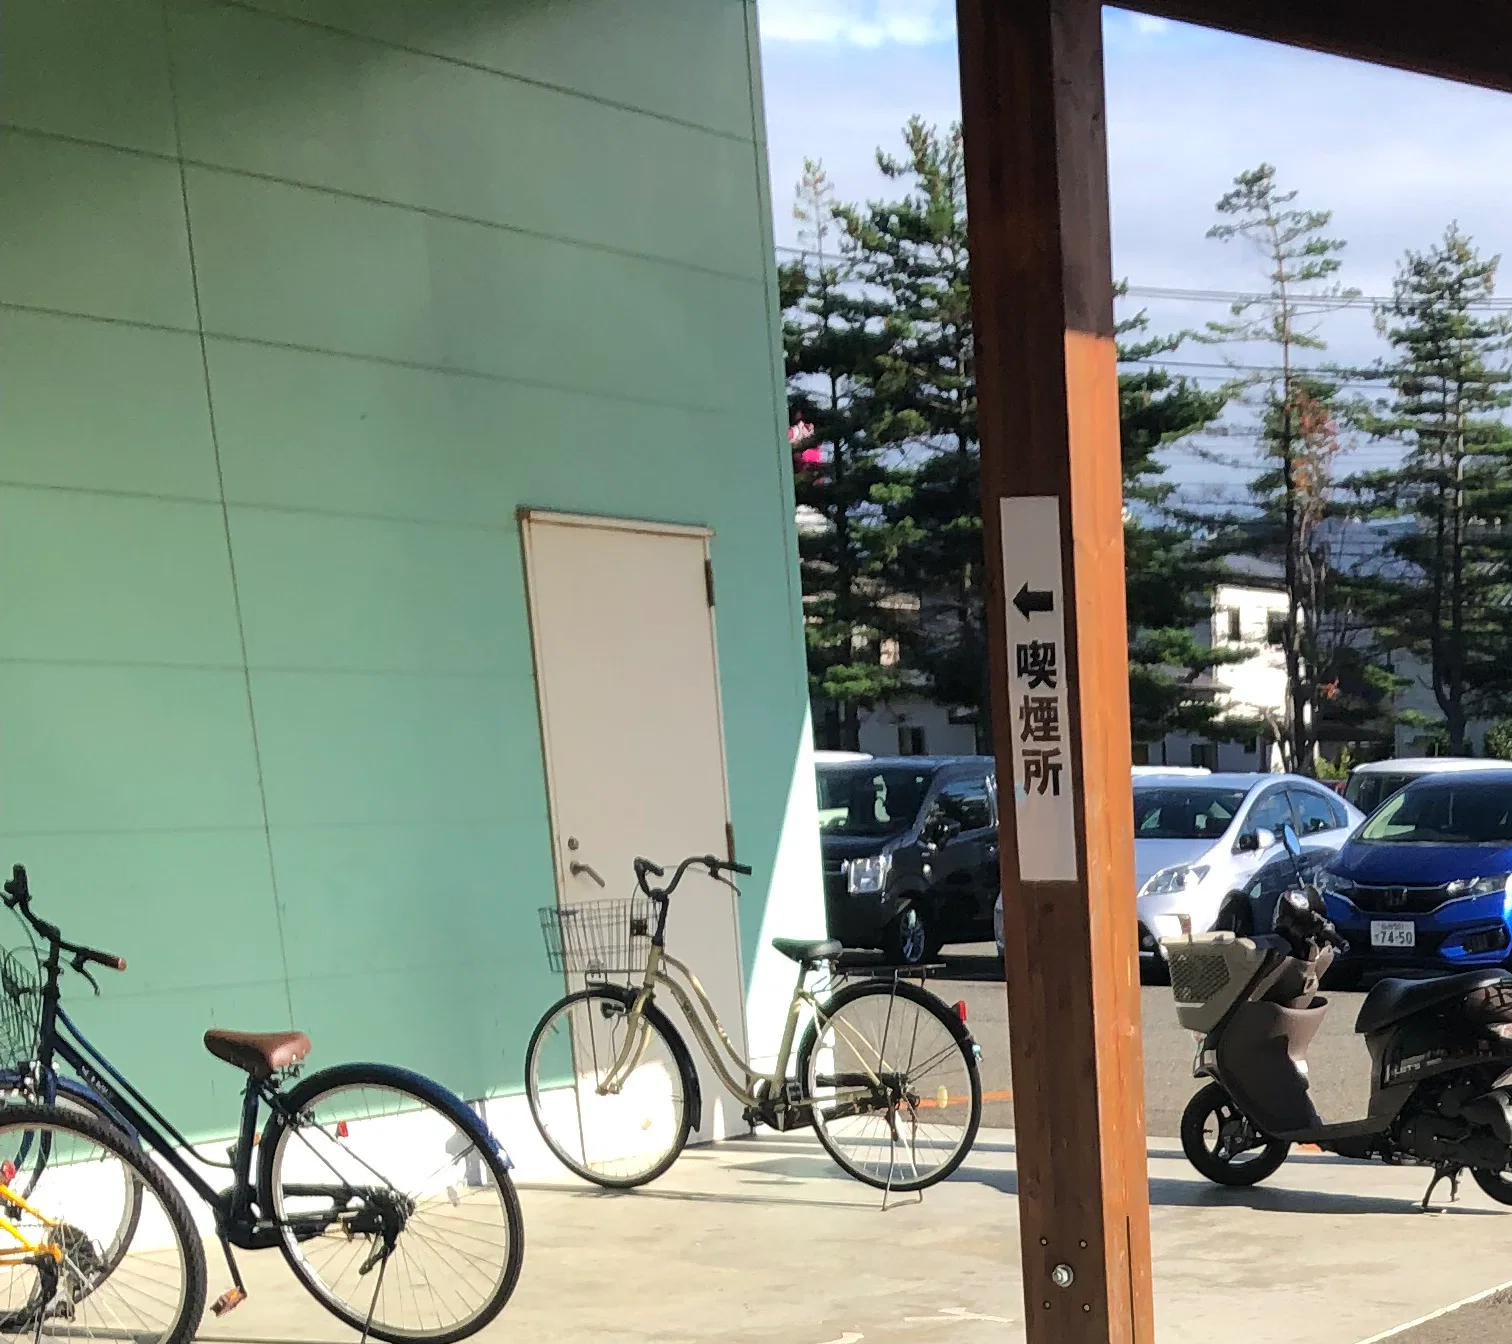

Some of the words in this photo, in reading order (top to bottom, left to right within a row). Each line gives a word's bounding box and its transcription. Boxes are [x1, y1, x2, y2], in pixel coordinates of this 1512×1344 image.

[1016, 639, 1063, 797] 喫煙所
[1380, 931, 1413, 945] 74-50
